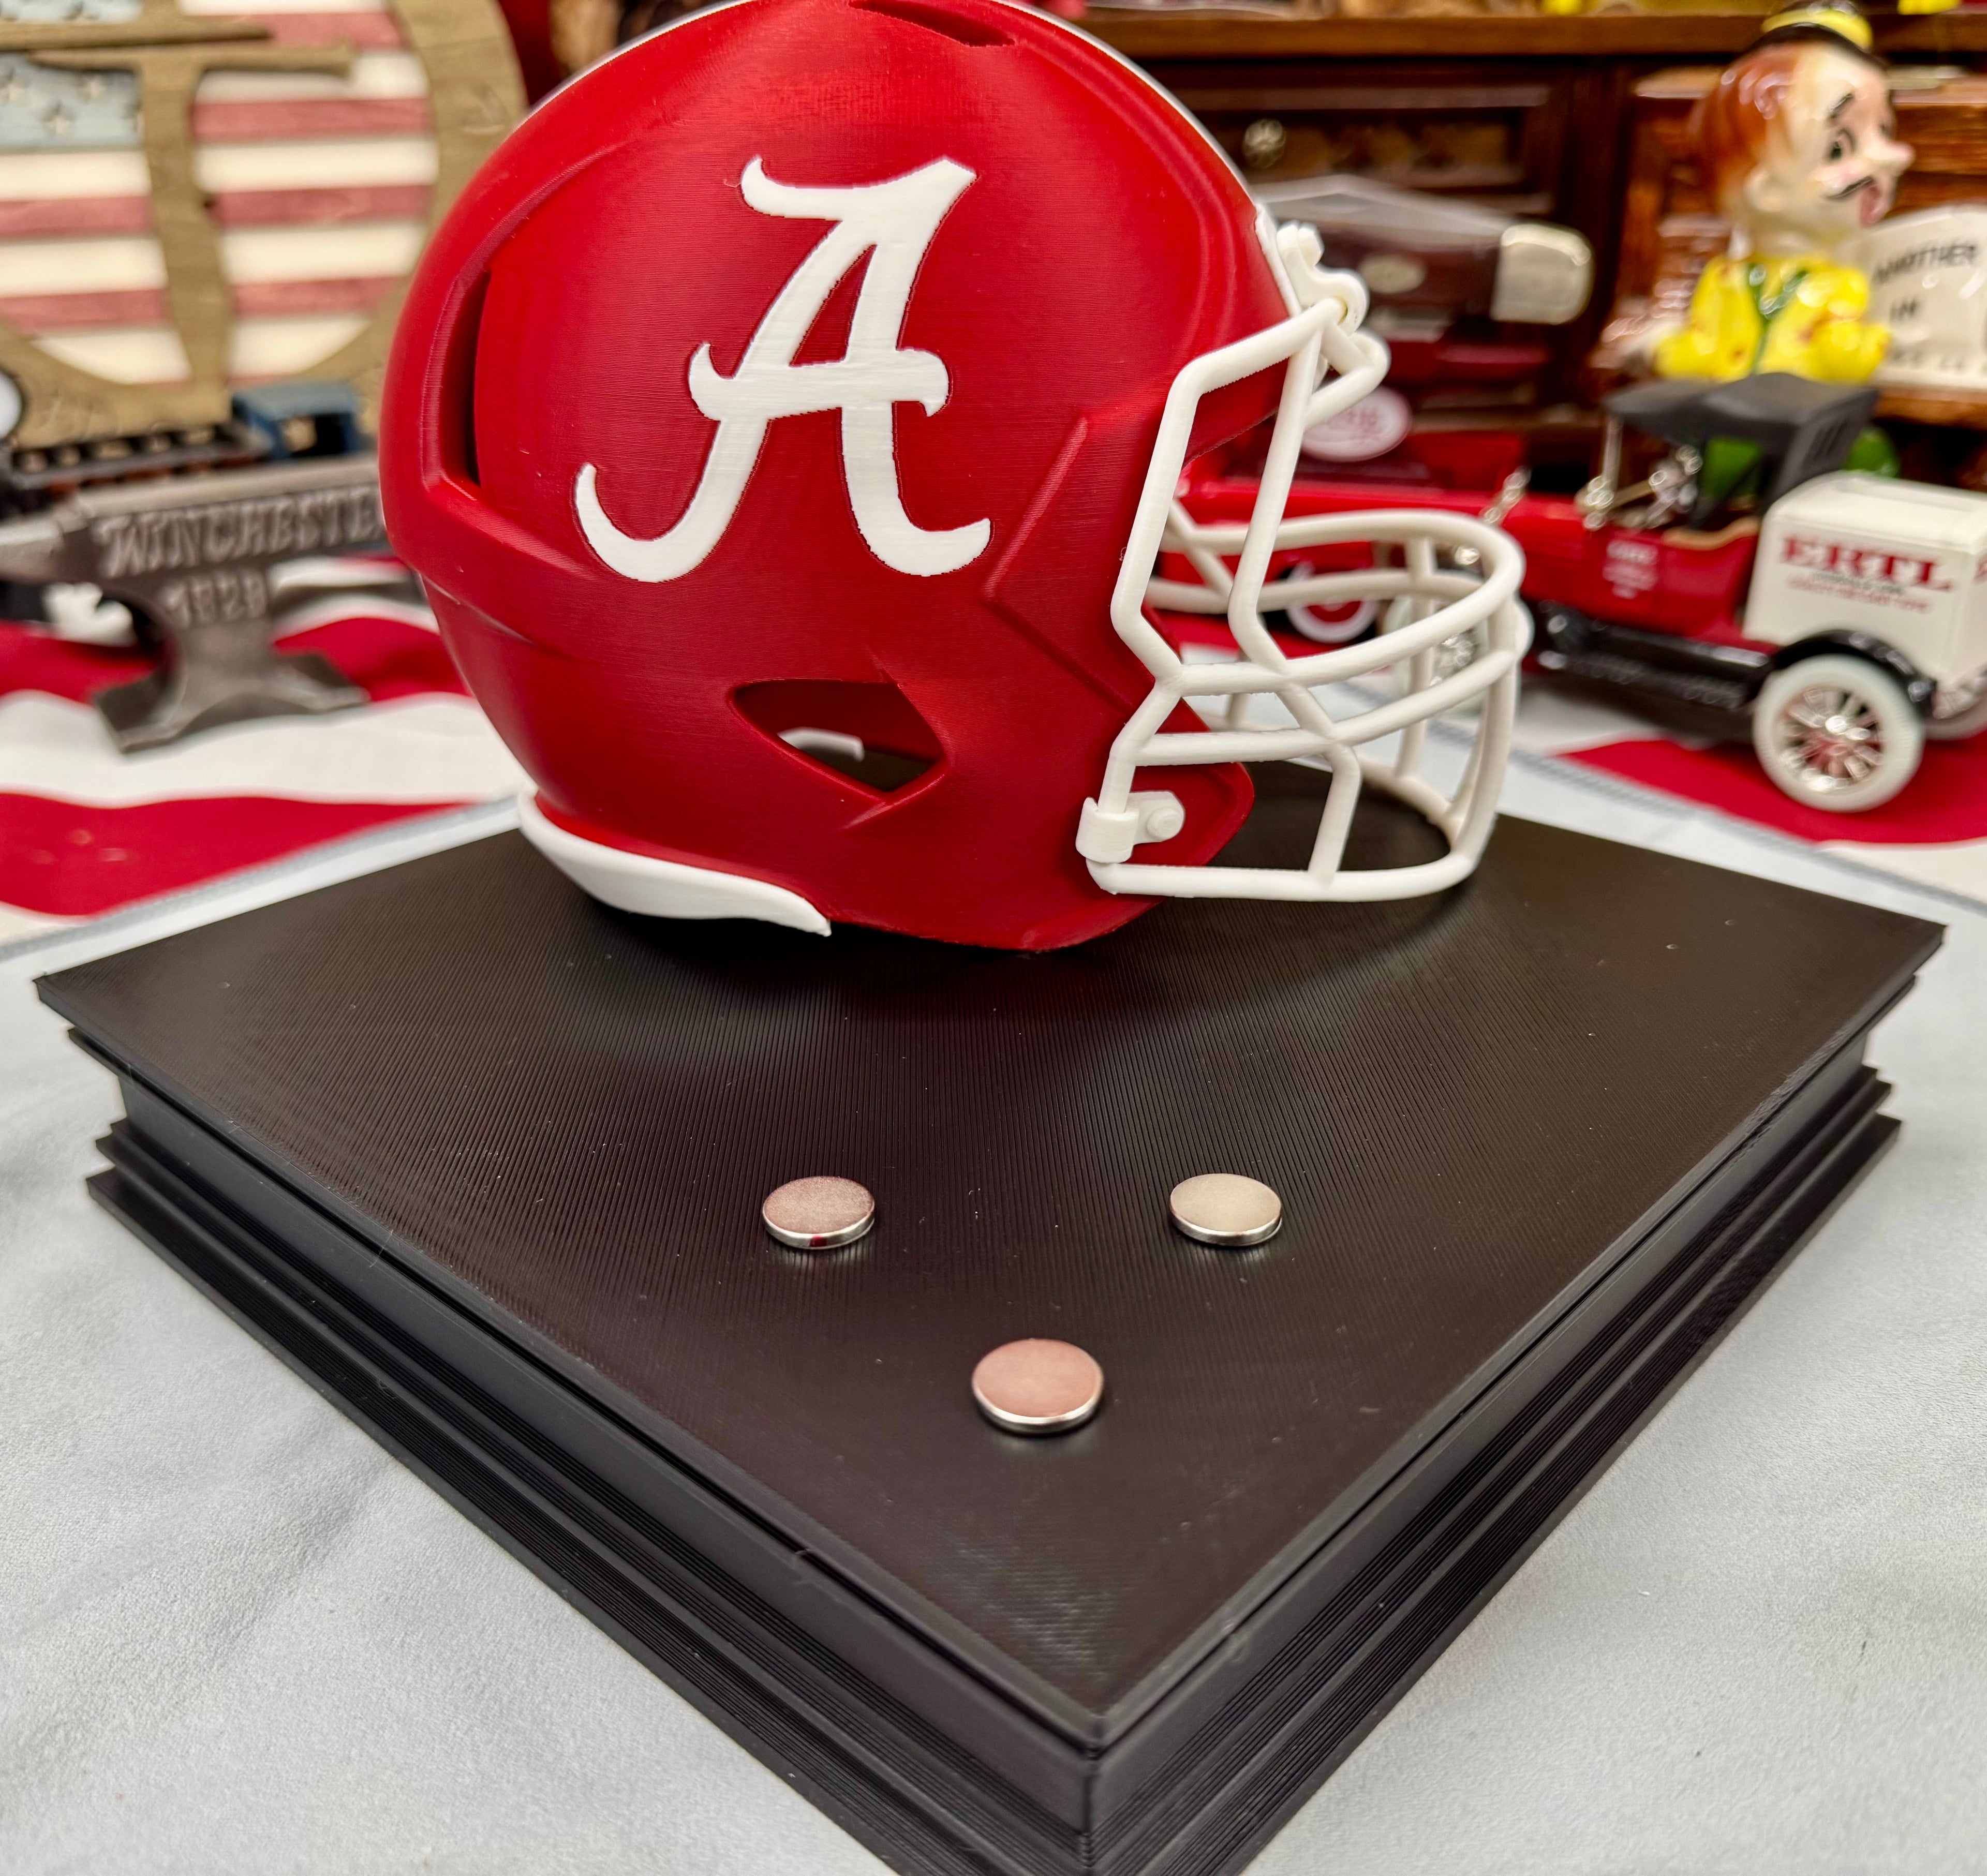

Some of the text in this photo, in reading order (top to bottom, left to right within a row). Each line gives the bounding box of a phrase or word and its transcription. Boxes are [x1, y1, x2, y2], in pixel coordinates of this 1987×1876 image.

[575, 155, 991, 584] A
[93, 485, 383, 578] WINCHESTE
[1782, 535, 1955, 592] ERTL
